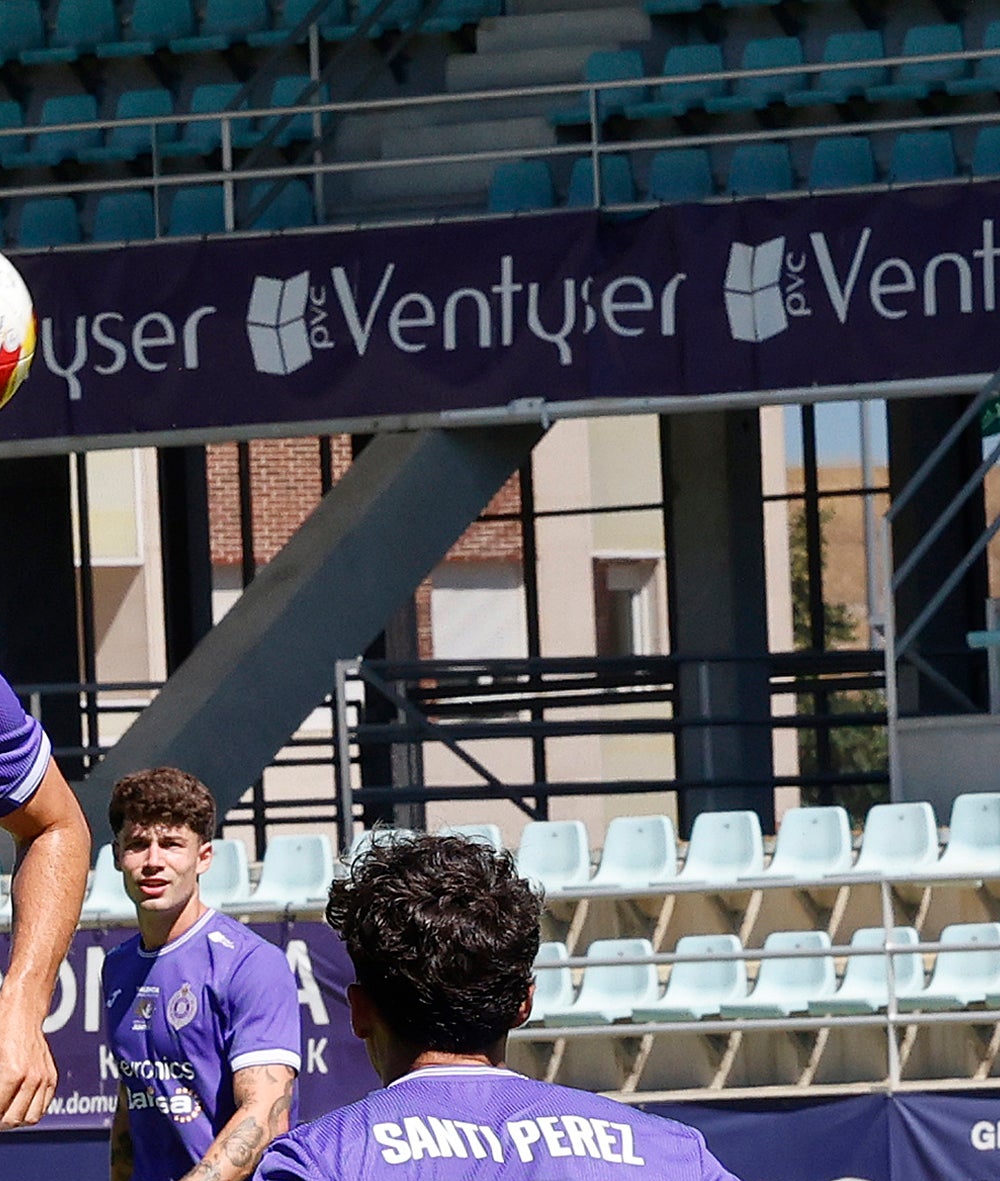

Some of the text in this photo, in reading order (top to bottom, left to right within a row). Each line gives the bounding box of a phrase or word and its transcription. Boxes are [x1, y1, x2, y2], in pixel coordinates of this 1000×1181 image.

[787, 219, 1000, 323] pvc Vent
[41, 305, 216, 400] yser
[310, 285, 335, 350] pvc
[371, 1114, 646, 1167] SANTI PEREZ
